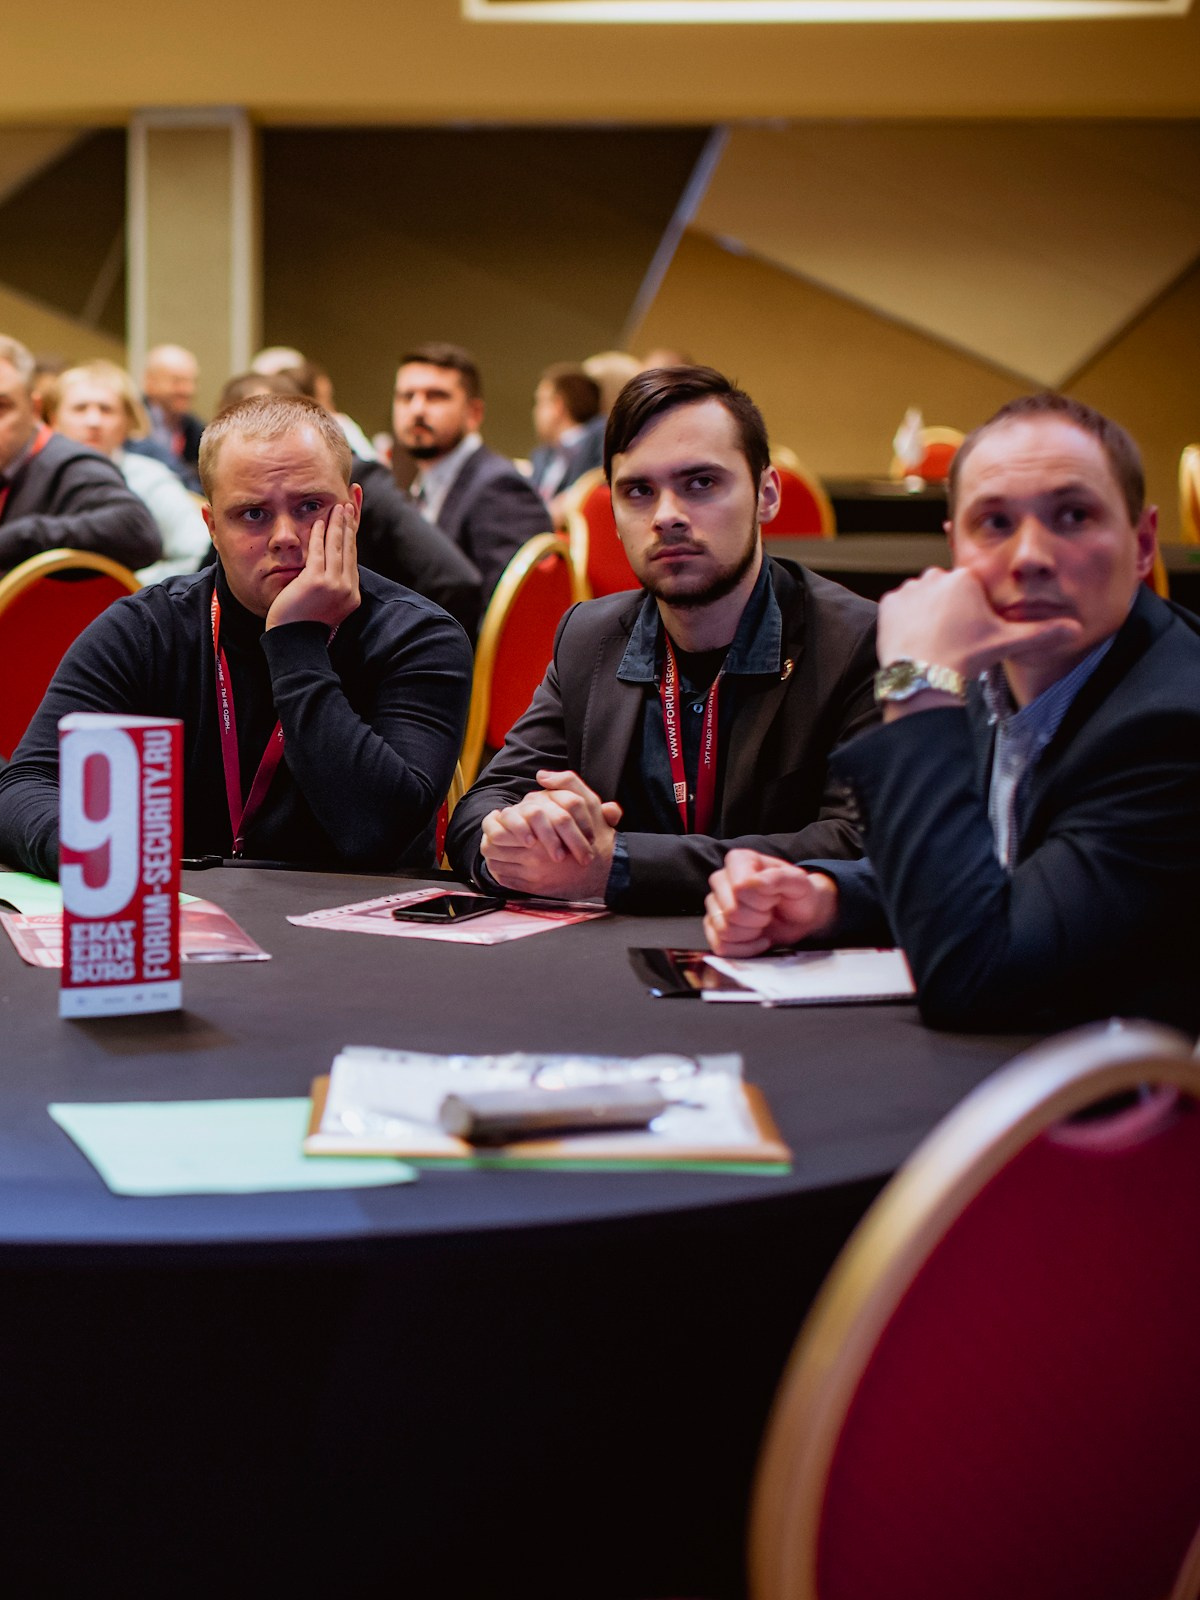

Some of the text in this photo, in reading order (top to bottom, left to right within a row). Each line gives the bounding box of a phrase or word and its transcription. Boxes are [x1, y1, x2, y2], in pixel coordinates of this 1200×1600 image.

[222, 698, 229, 708] НЕ
[706, 691, 714, 727] РАБОТАТЬ
[60, 729, 140, 918] 9
[143, 729, 172, 979] FORUM-SECURITY.RU
[70, 921, 136, 943] EKAT
[70, 942, 135, 964] ERIN
[70, 962, 135, 983] BURG
